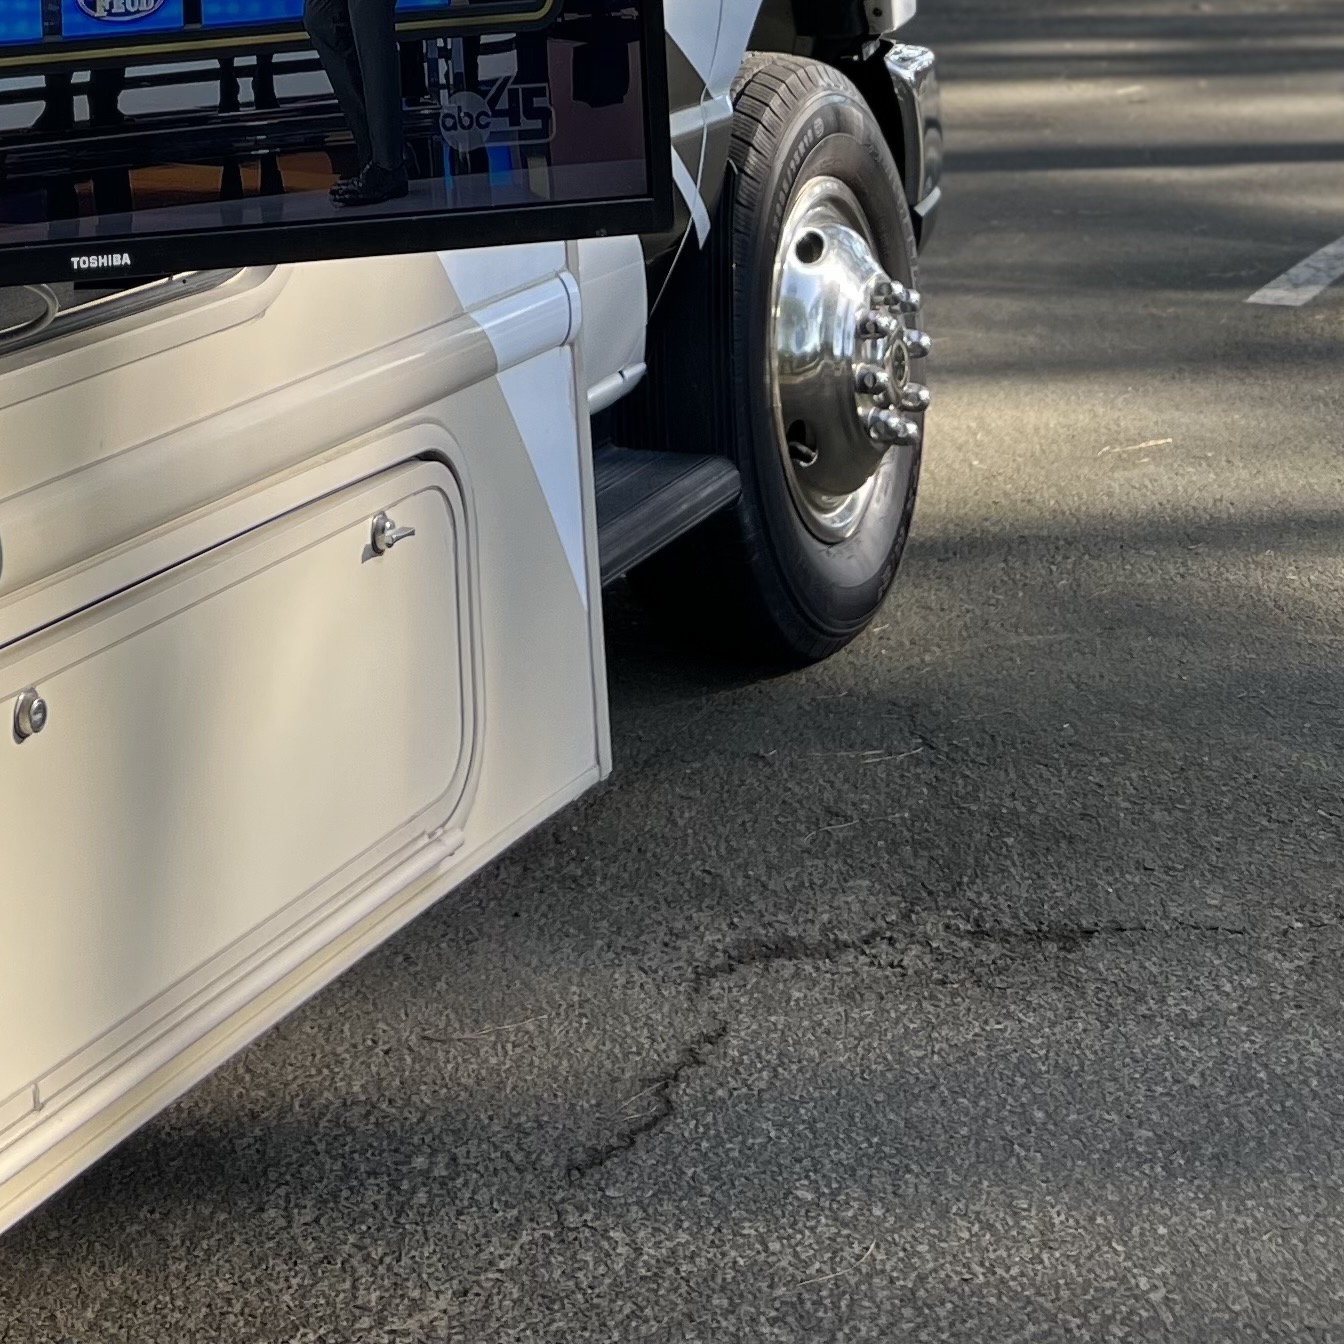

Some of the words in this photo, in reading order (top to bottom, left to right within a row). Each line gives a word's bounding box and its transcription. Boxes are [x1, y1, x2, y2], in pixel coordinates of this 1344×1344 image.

[441, 105, 492, 132] abc
[486, 74, 555, 144] 45
[70, 253, 131, 269] TOSHIBA
